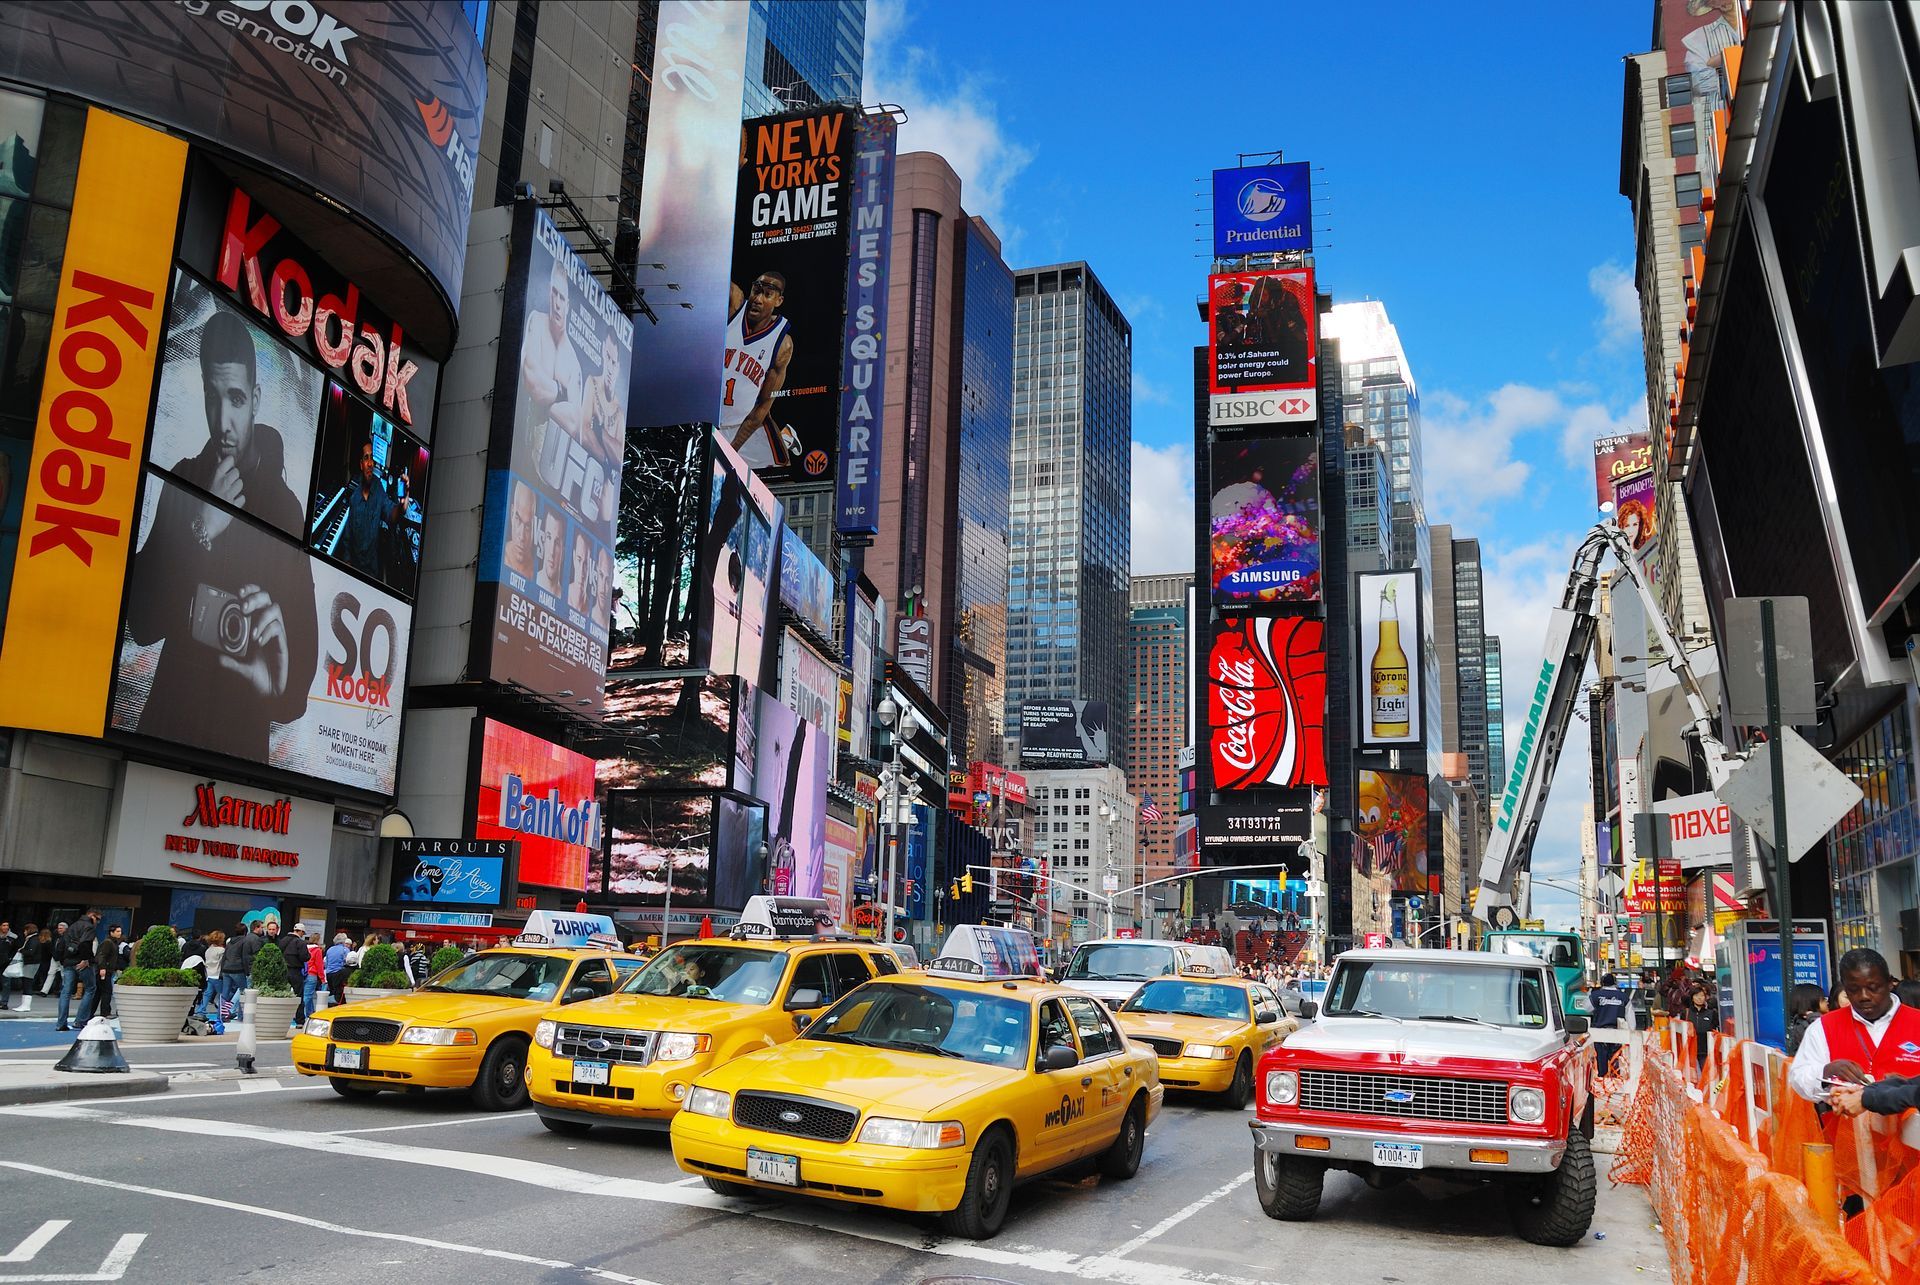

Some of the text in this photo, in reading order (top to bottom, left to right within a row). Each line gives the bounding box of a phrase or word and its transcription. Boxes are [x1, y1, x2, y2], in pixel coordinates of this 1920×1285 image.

[216, 9, 348, 86] emotion
[756, 113, 843, 165] NEW
[756, 155, 840, 192] YORK'S
[752, 182, 838, 227] GAME
[752, 232, 764, 240] TEXT
[813, 221, 838, 230] (KNICKS)
[768, 235, 790, 244] CHANCE
[800, 232, 814, 240] MEET
[815, 228, 837, 238] AMAR'E
[1226, 224, 1302, 244] Prudential
[536, 210, 579, 287] LESNAR
[217, 187, 419, 426] Kodak
[848, 150, 885, 486] TIMES SQUARE
[1217, 350, 1280, 361] 0.3% of Saharan
[1218, 358, 1289, 372] solar energy could
[735, 351, 765, 389] YORK
[1218, 370, 1274, 380] power Europe.
[724, 378, 736, 406] 1
[770, 390, 791, 398] AMAR'E
[29, 269, 155, 568] Kodak
[1216, 400, 1276, 418] HSBC
[1595, 436, 1628, 448] NATHAN
[1596, 446, 1616, 456] LANE
[540, 418, 604, 522] UFC
[846, 506, 866, 516] NYC
[1231, 570, 1301, 584] SAMSUNG
[500, 604, 525, 632] LIVE
[528, 620, 544, 642] ON
[510, 594, 536, 622] SAT.
[540, 611, 588, 653] OCTOBER
[590, 642, 601, 660] 23
[325, 591, 398, 689] SO
[327, 662, 391, 709] Kodak
[1374, 670, 1406, 684] Corona
[1219, 656, 1258, 770] Coca-Cola
[1377, 697, 1406, 712] Light
[318, 724, 388, 756] SHARE YOUR SO KODAK
[330, 742, 375, 764] MOMENT HERE
[1497, 658, 1556, 832] LANDMARK
[183, 781, 292, 836] Marriott
[499, 772, 590, 846] Bank of
[165, 834, 300, 868] NEW YORK MARQUIS
[401, 841, 506, 854] MARQUIS
[414, 858, 496, 899] Come Fly Away
[420, 913, 440, 924] THARP
[458, 914, 486, 926] SINATRA
[552, 919, 600, 936] ZURICH
[637, 914, 686, 922] AMERCAN
[741, 924, 761, 935] 3P44
[944, 960, 968, 971] 4A11
